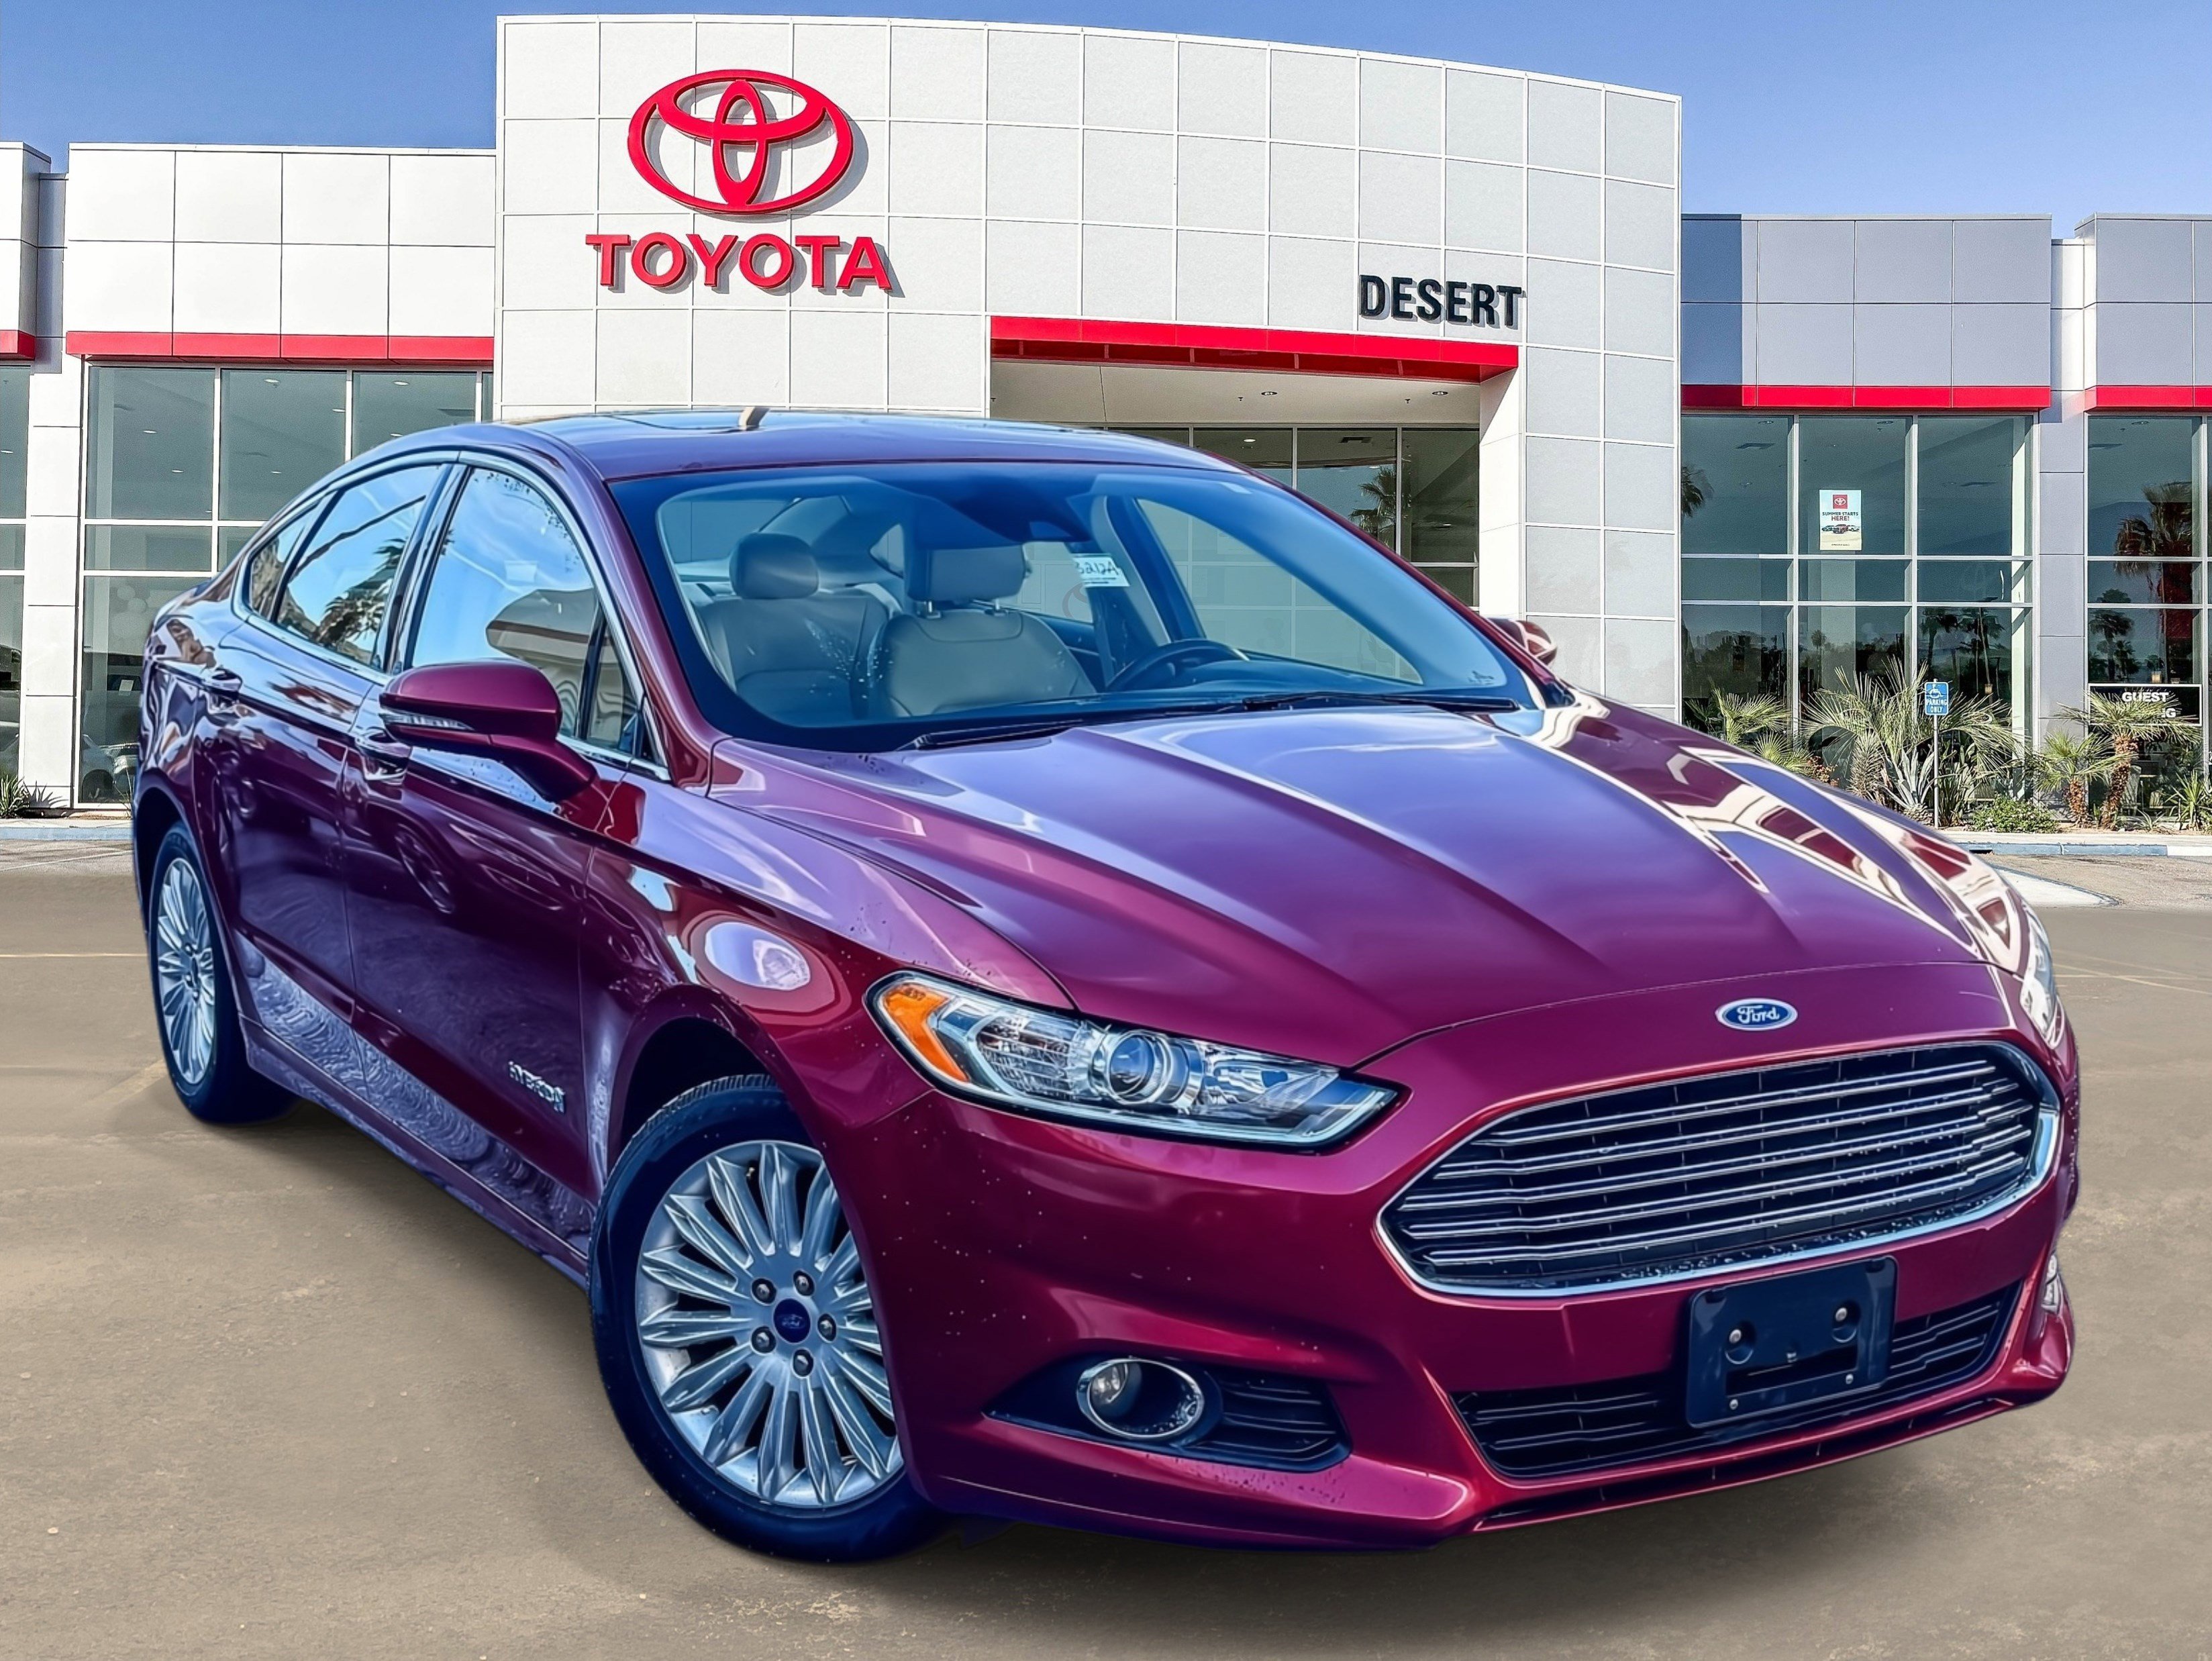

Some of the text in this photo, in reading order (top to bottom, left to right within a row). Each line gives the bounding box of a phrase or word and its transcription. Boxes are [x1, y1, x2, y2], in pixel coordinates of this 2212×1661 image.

[585, 232, 893, 290] TOYOTA
[1359, 274, 1522, 328] DESERT
[1926, 699, 1948, 707] PARKING
[2121, 691, 2170, 703] GUEST
[1736, 1004, 1780, 1024] Ford
